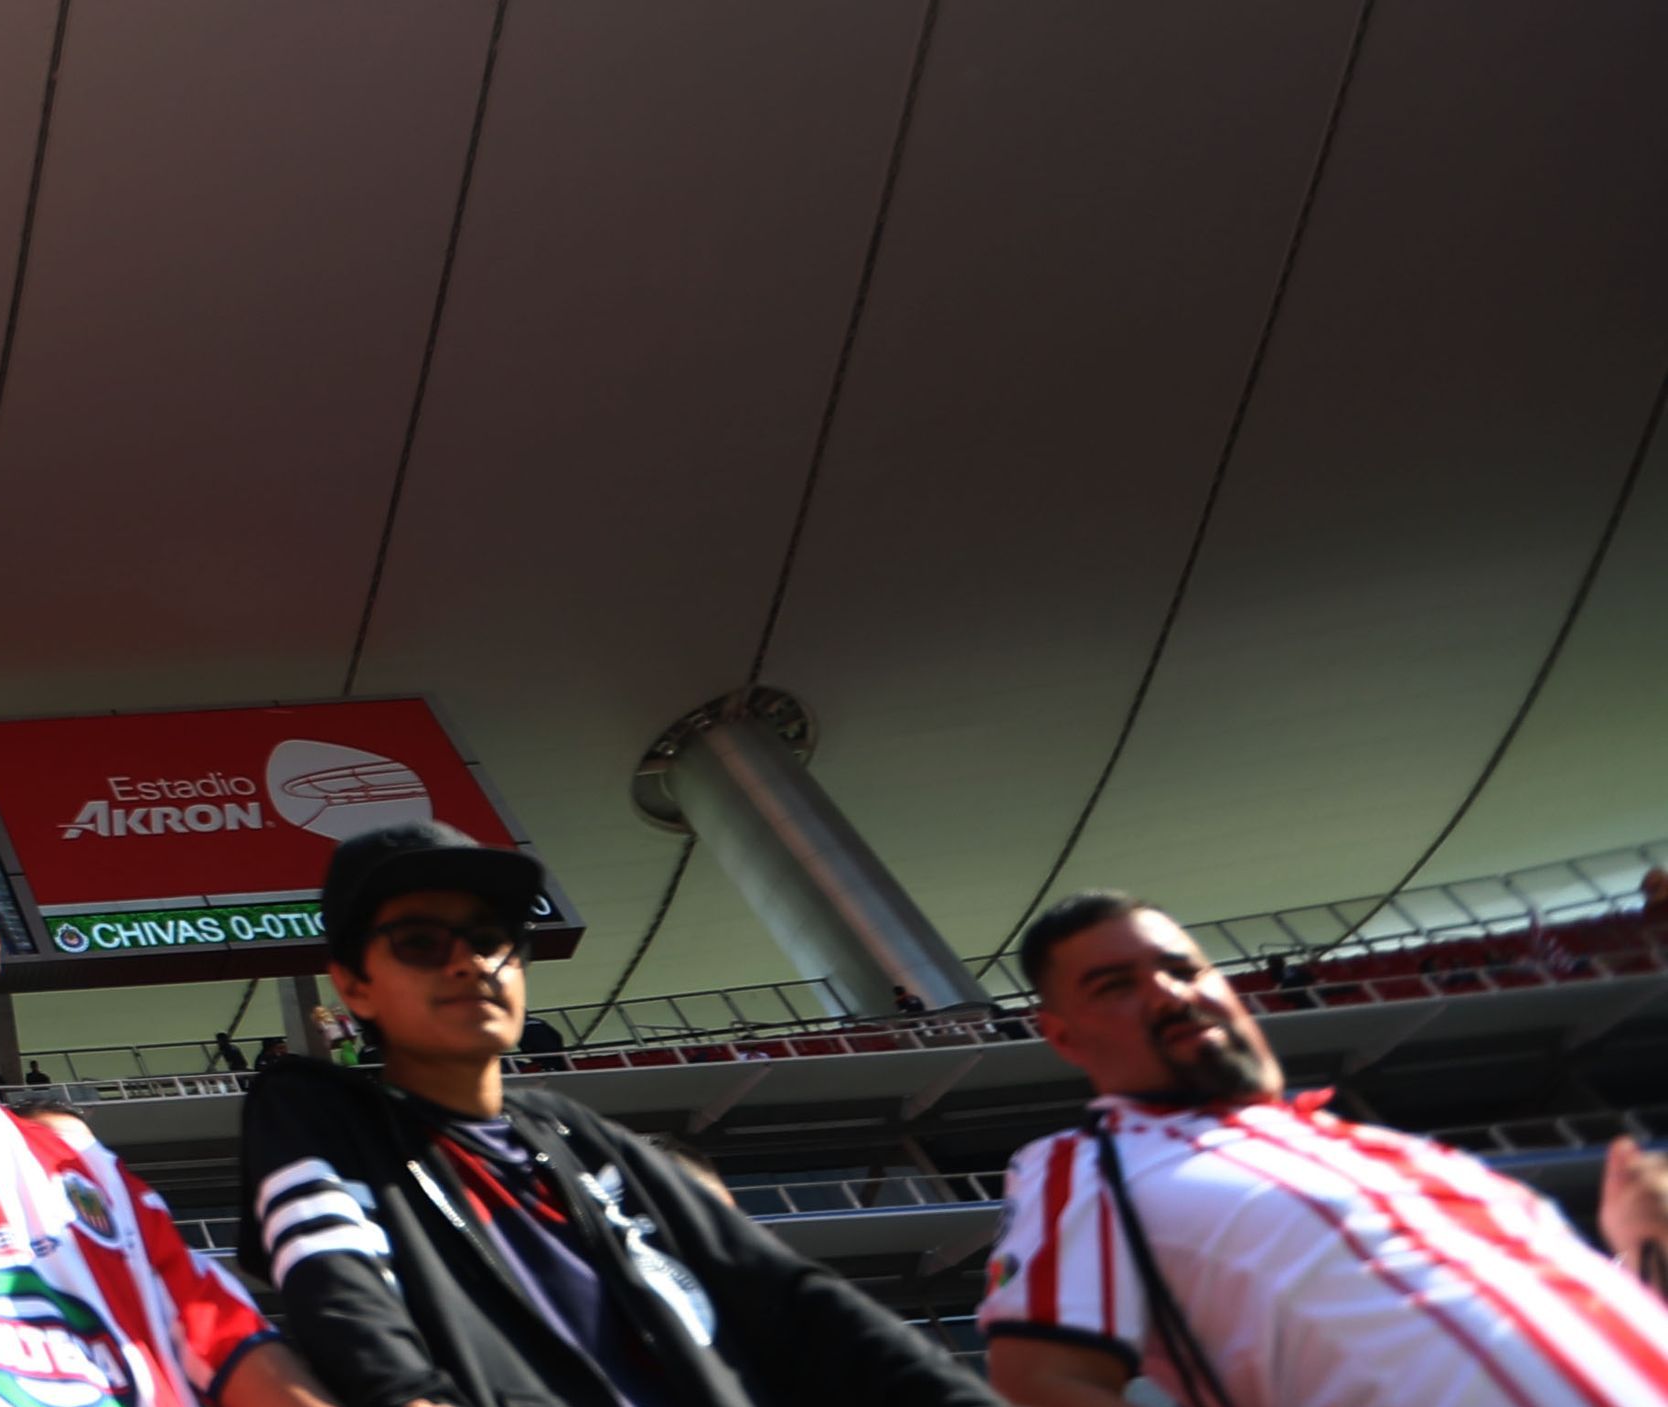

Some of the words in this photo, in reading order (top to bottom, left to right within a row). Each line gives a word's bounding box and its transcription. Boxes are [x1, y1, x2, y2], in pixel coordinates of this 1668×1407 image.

[107, 771, 257, 802] Estadio
[56, 800, 264, 840] AKRON
[91, 916, 226, 950] CHIVAS
